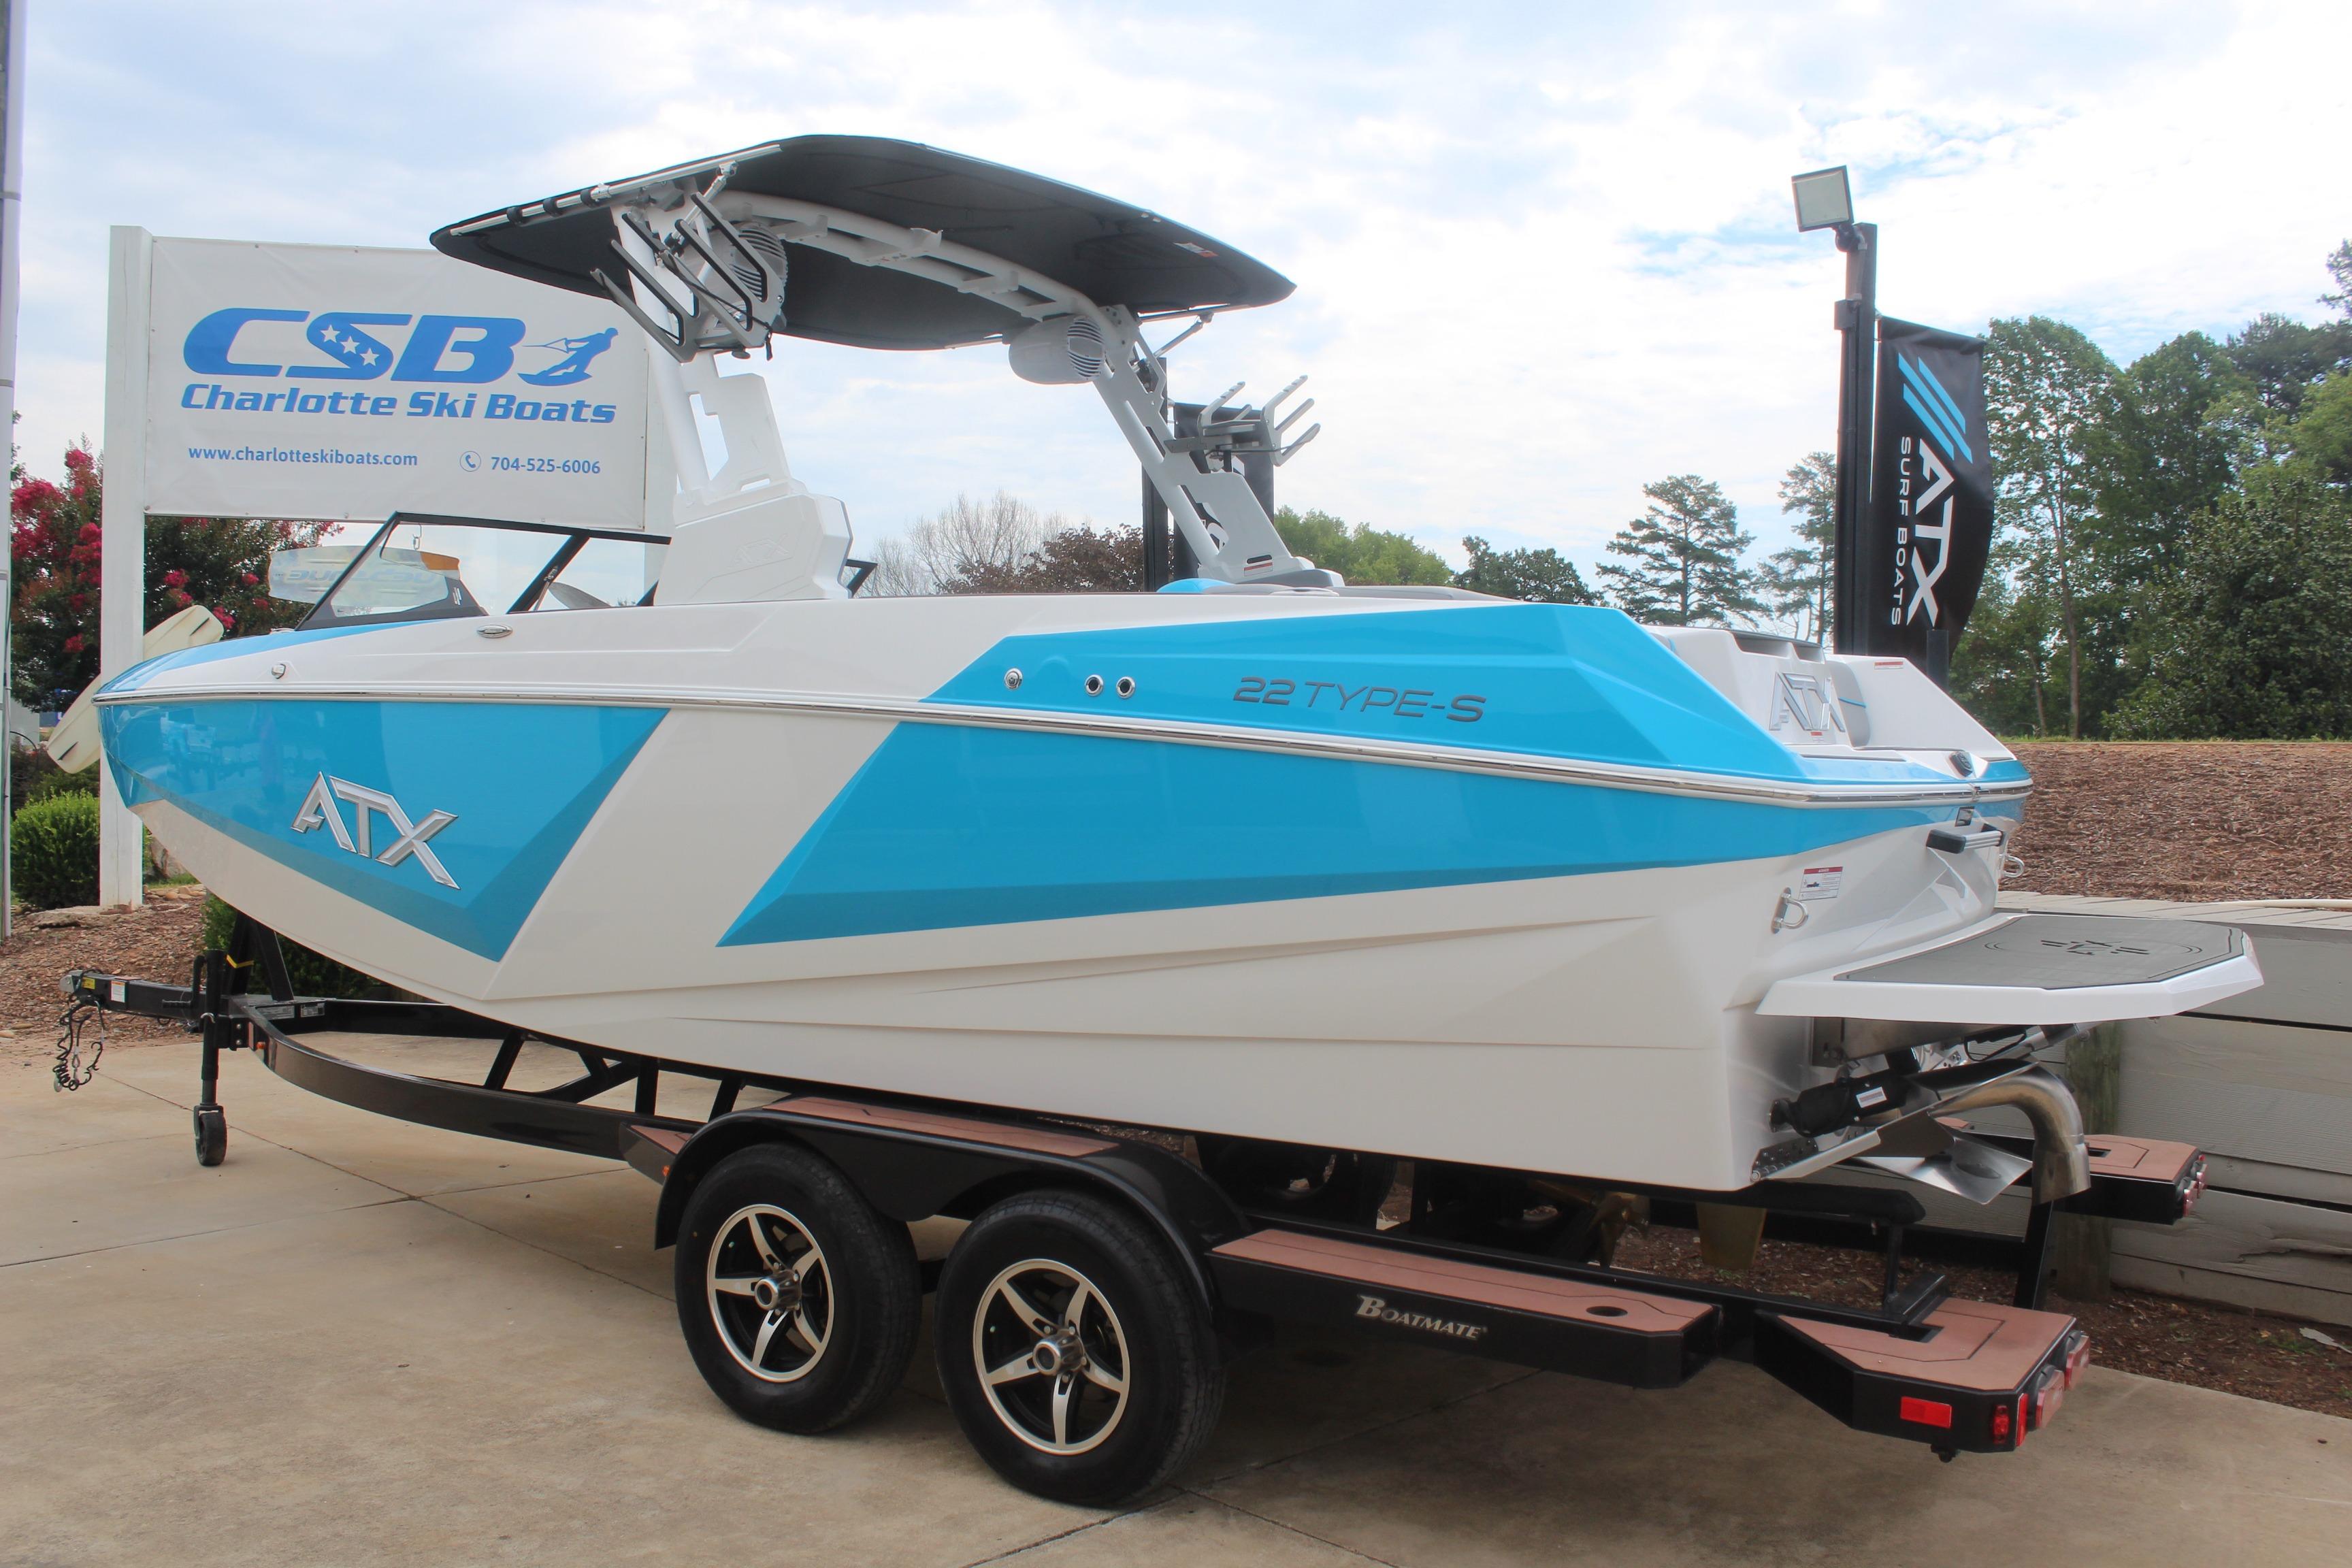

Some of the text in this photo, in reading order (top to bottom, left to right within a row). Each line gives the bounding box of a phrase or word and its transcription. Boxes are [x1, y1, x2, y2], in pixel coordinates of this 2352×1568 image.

[184, 308, 525, 383] CSB
[180, 382, 617, 424] Charlotte Ski Boats
[188, 445, 418, 467] www.charlotteskiboats.com
[491, 456, 601, 476] 704-525-6006
[1891, 436, 1912, 626] SURF BOATS
[1906, 438, 1955, 627] ATX
[1232, 676, 1487, 723] 22 TYPE-S
[290, 770, 461, 891] ATX
